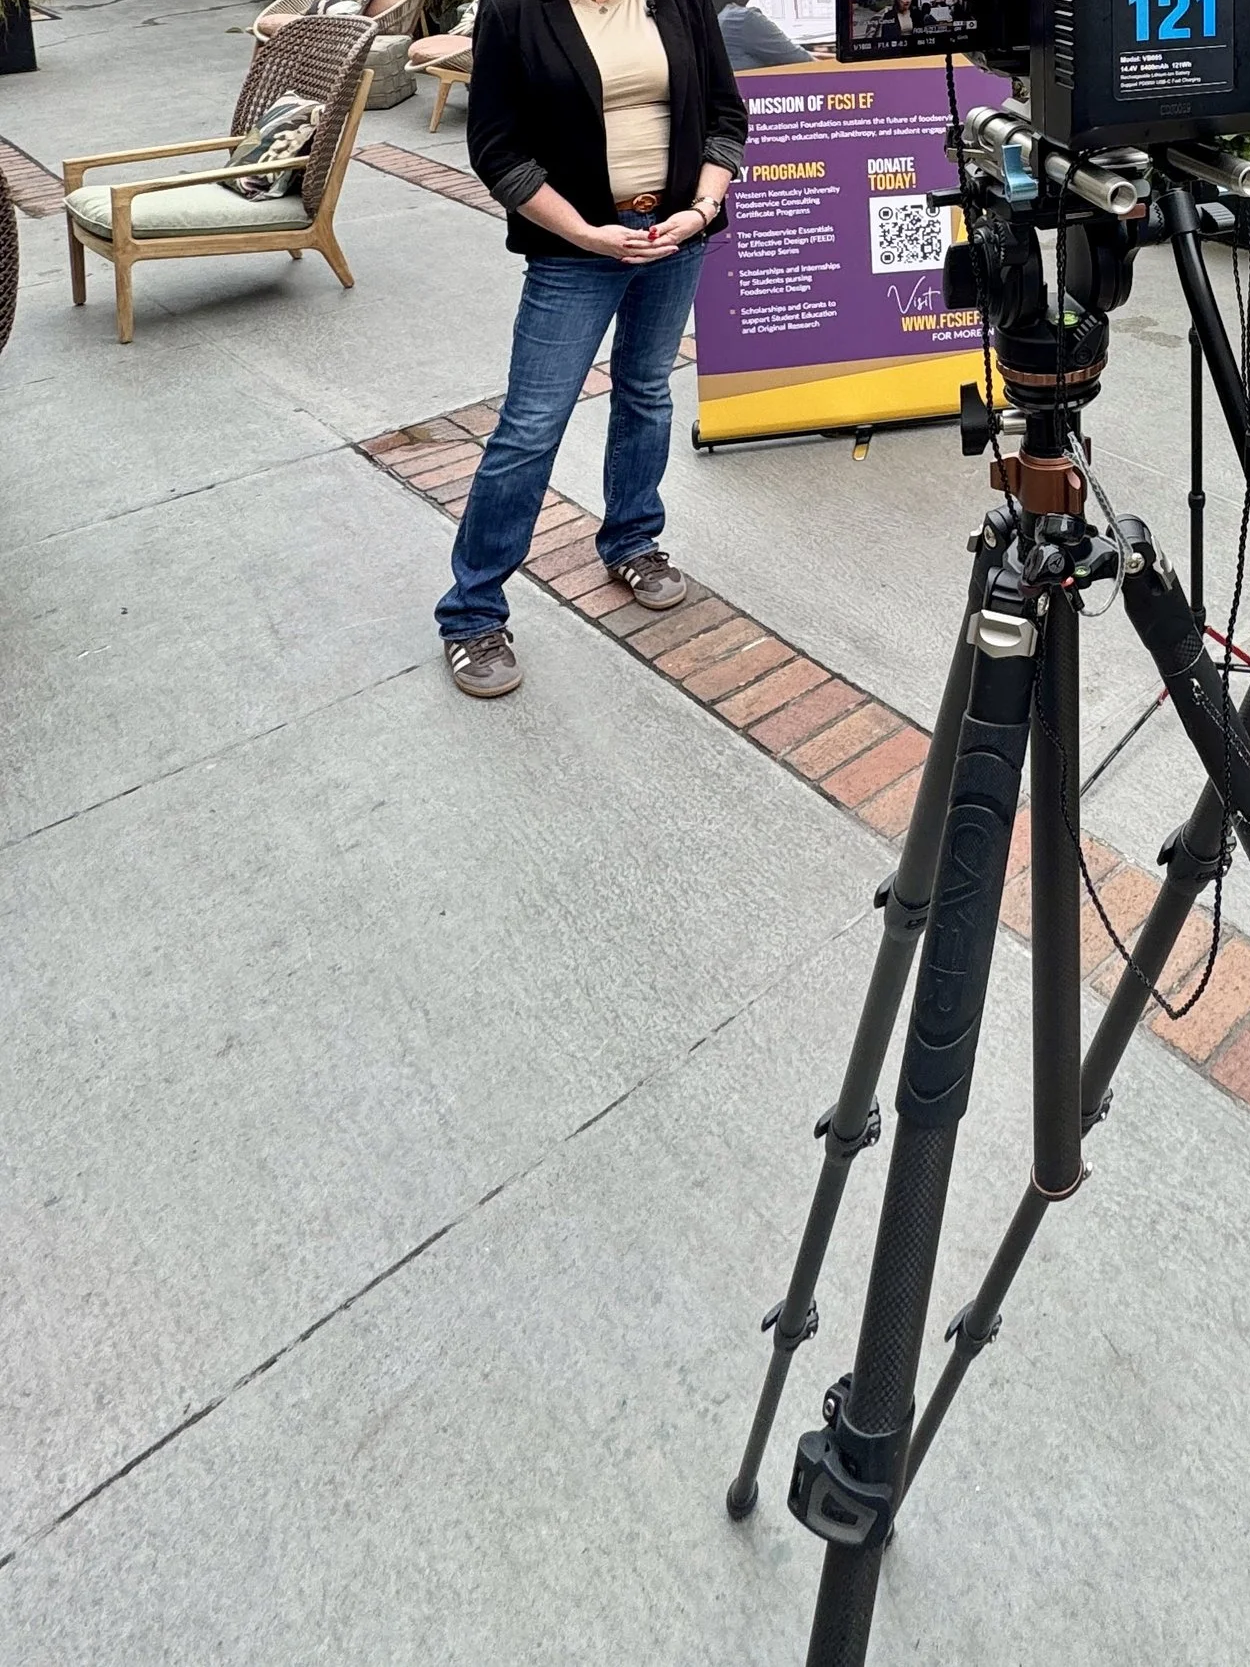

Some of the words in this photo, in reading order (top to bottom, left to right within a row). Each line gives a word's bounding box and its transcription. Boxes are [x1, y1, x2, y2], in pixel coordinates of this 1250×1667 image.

[749, 96, 804, 115] MISSION
[807, 94, 824, 112] OF
[827, 93, 855, 111] FCSI
[859, 92, 874, 109] EF
[756, 122, 799, 131] Educational
[800, 119, 842, 129] Foundation
[843, 117, 872, 126] sustains
[873, 117, 885, 125] the
[886, 116, 908, 124] future
[909, 115, 917, 123] of
[918, 114, 953, 122] foodservi
[761, 135, 790, 143] through
[791, 131, 829, 141] education,
[878, 128, 892, 136] and
[893, 127, 920, 135] student
[921, 126, 946, 135] engage
[753, 161, 825, 182] PROGRAMS
[867, 156, 915, 174] DONATE
[868, 173, 917, 191] TODAY!
[735, 191, 767, 200] Western
[768, 188, 802, 198] Kentucky
[804, 185, 840, 195] University
[735, 199, 780, 209] Foodservice
[781, 196, 821, 206] Consulting
[736, 209, 774, 219] Certificate
[776, 207, 810, 216] Programs
[737, 231, 751, 239] The
[753, 228, 797, 238] Foodservice
[798, 225, 834, 234] Essentials
[738, 241, 748, 249] for
[750, 238, 782, 248] Effective
[783, 236, 808, 246] Design
[810, 234, 835, 244] (FEED)
[738, 248, 776, 258] Workshop
[777, 247, 800, 256] Series
[739, 267, 784, 277] Scholarships
[785, 265, 799, 274] and
[801, 262, 841, 272] Internships
[739, 279, 750, 287] for
[752, 276, 784, 286] Students
[740, 286, 784, 296] Foodservice
[785, 284, 811, 293] Design
[887, 275, 941, 314] Visit
[741, 305, 786, 315] Scholarships
[787, 303, 801, 312] and
[802, 301, 827, 310] Grants
[828, 300, 836, 308] to
[741, 316, 770, 326] support
[771, 313, 800, 323] Student
[801, 310, 837, 320] Education
[901, 310, 983, 332] WWW.FCSIEF.
[742, 326, 756, 335] and
[757, 323, 786, 334] Original
[787, 320, 821, 330] Research
[932, 332, 952, 341] FOR
[953, 328, 983, 339] MORE
